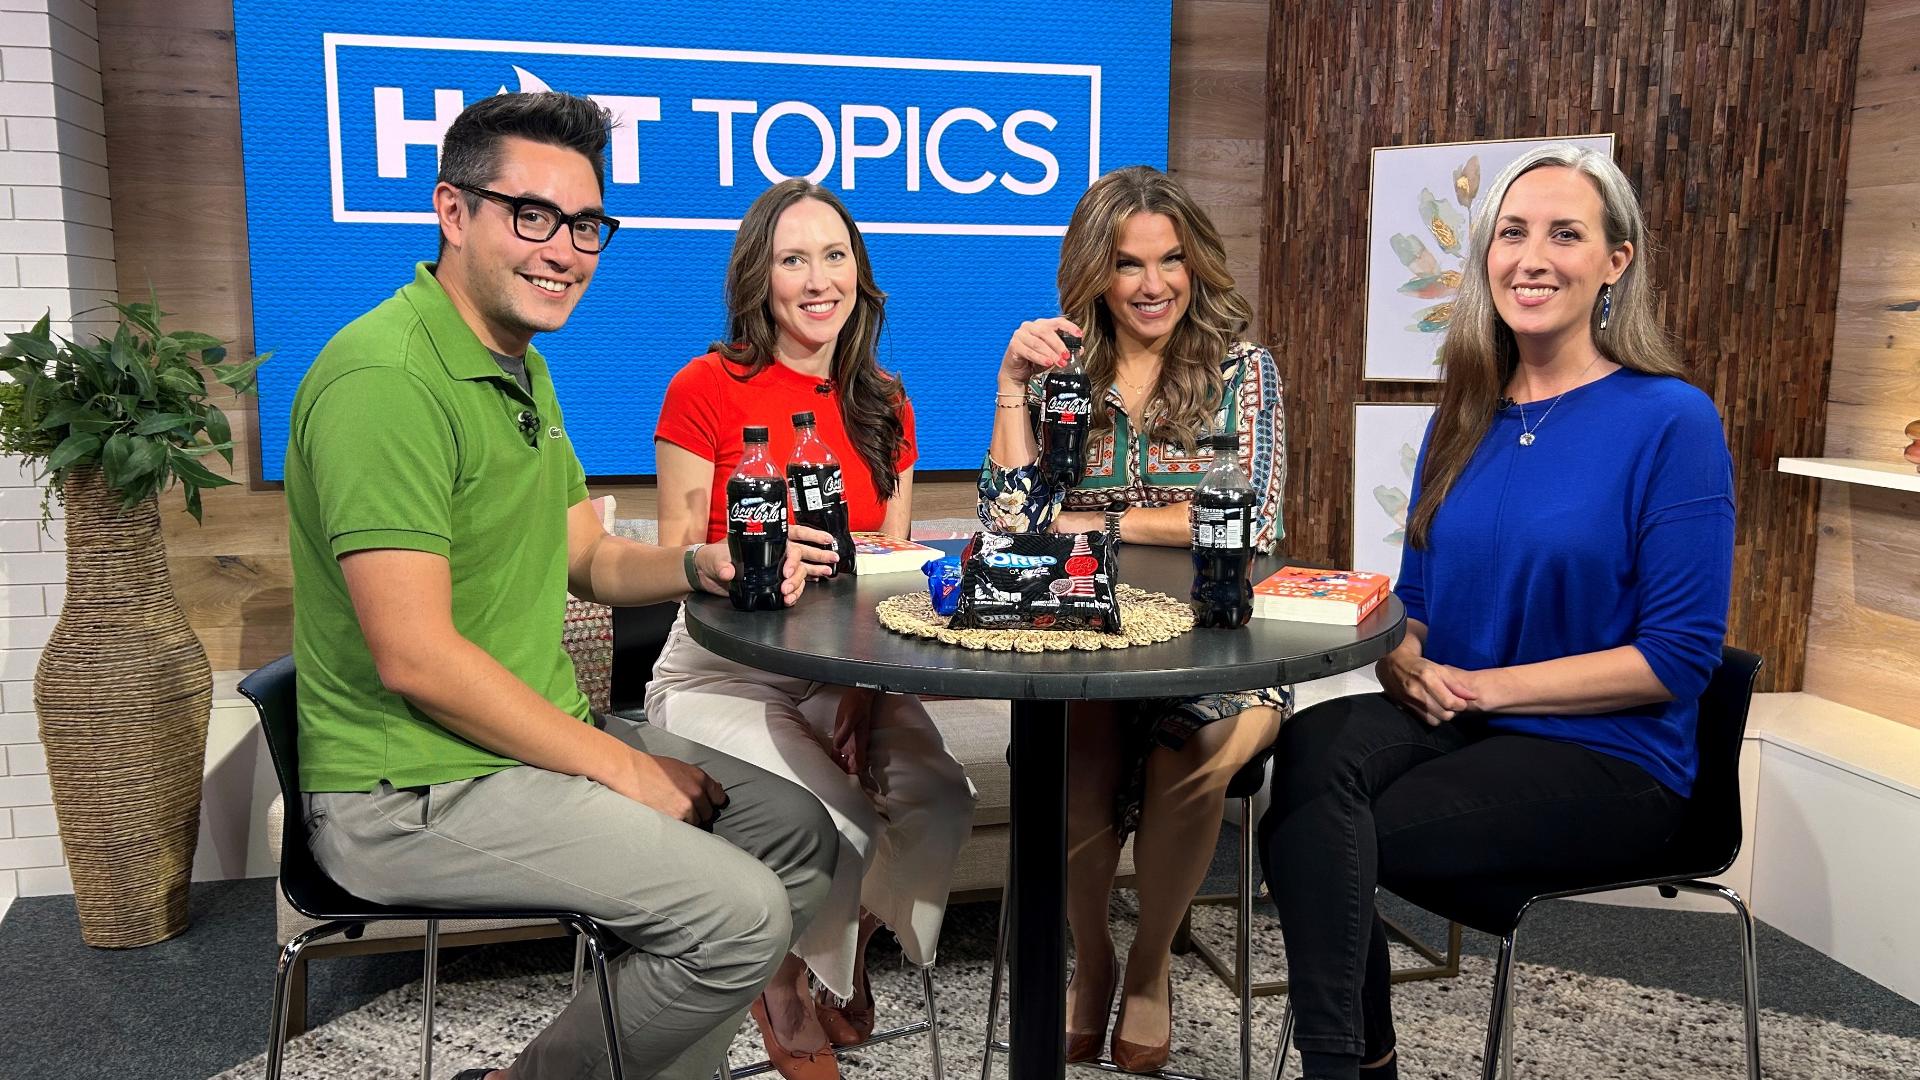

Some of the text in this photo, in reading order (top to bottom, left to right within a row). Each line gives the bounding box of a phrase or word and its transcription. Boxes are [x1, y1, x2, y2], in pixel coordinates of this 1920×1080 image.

[374, 66, 1060, 195] HT TOPICS
[1047, 396, 1089, 415] Coca-Cola
[730, 500, 782, 523] Coca-Cola
[986, 552, 1057, 567] OREO
[981, 614, 1020, 622] OREO
